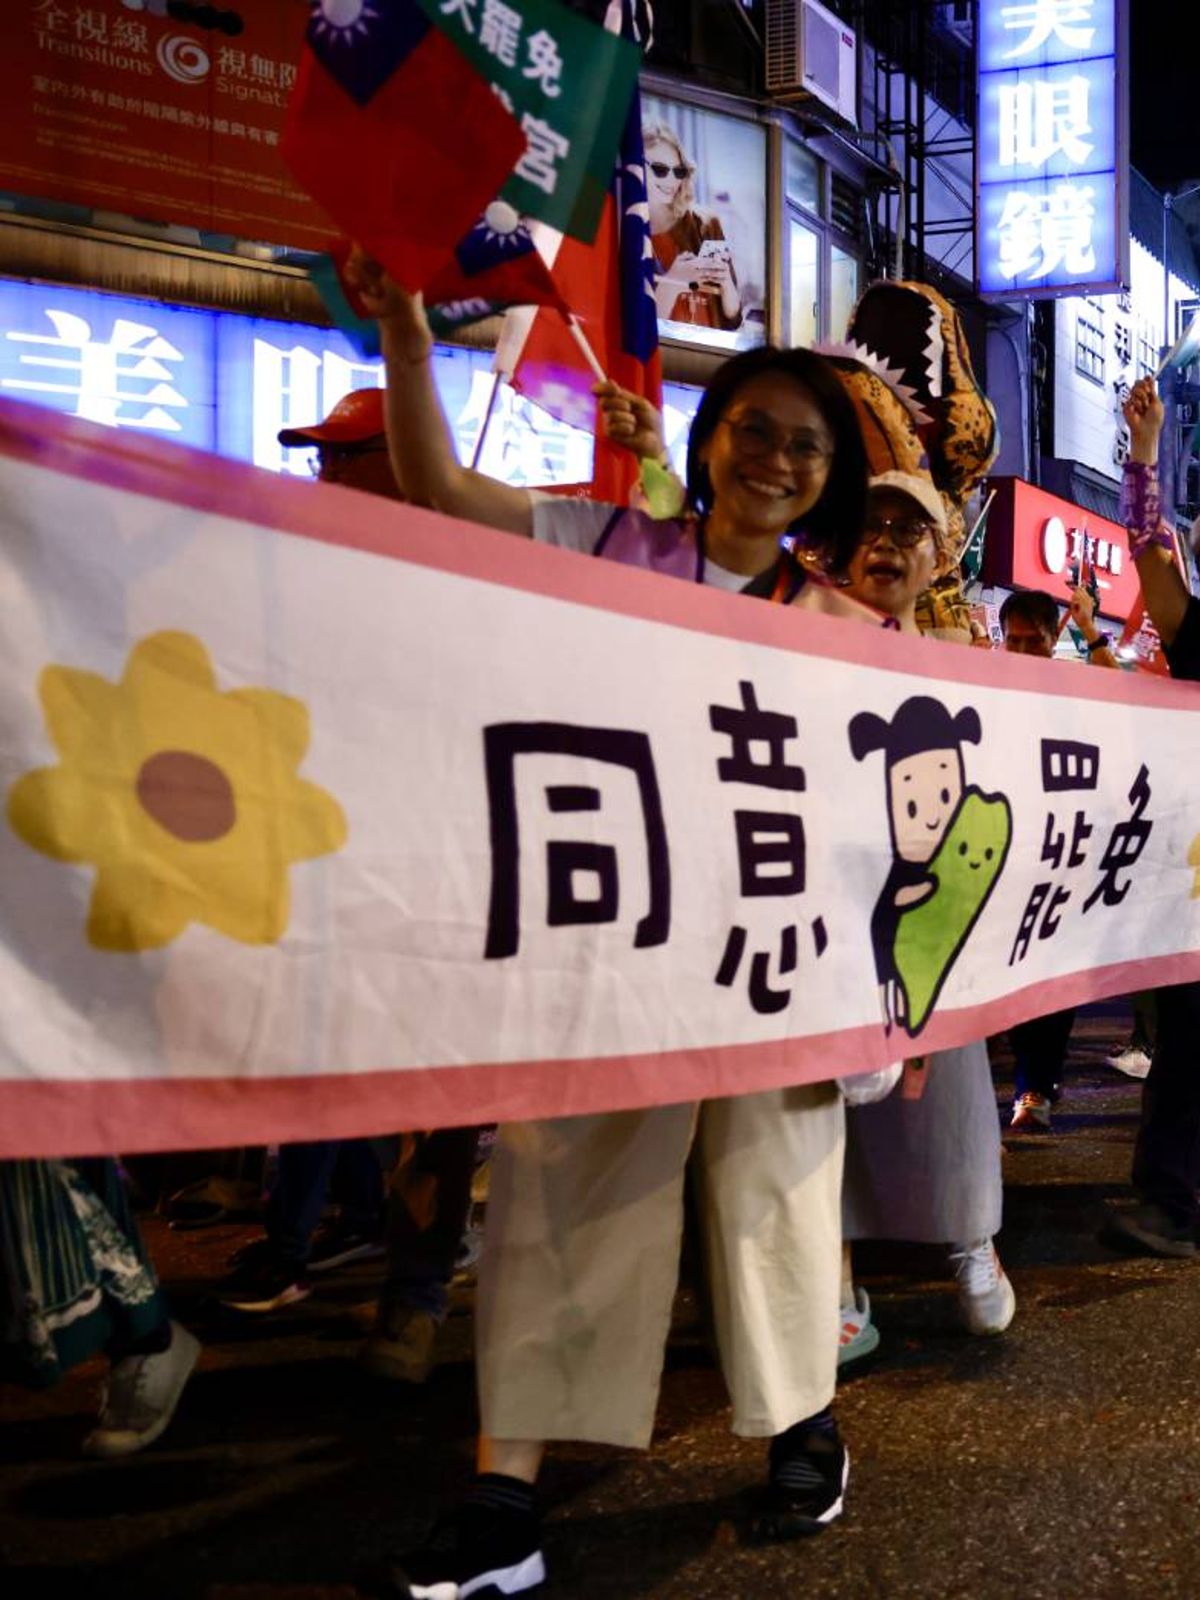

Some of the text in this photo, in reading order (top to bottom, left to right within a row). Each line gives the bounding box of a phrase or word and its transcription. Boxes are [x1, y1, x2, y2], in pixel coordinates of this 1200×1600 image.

[215, 76, 287, 107] Signat
[483, 680, 1153, 1014] 同意 罷免
